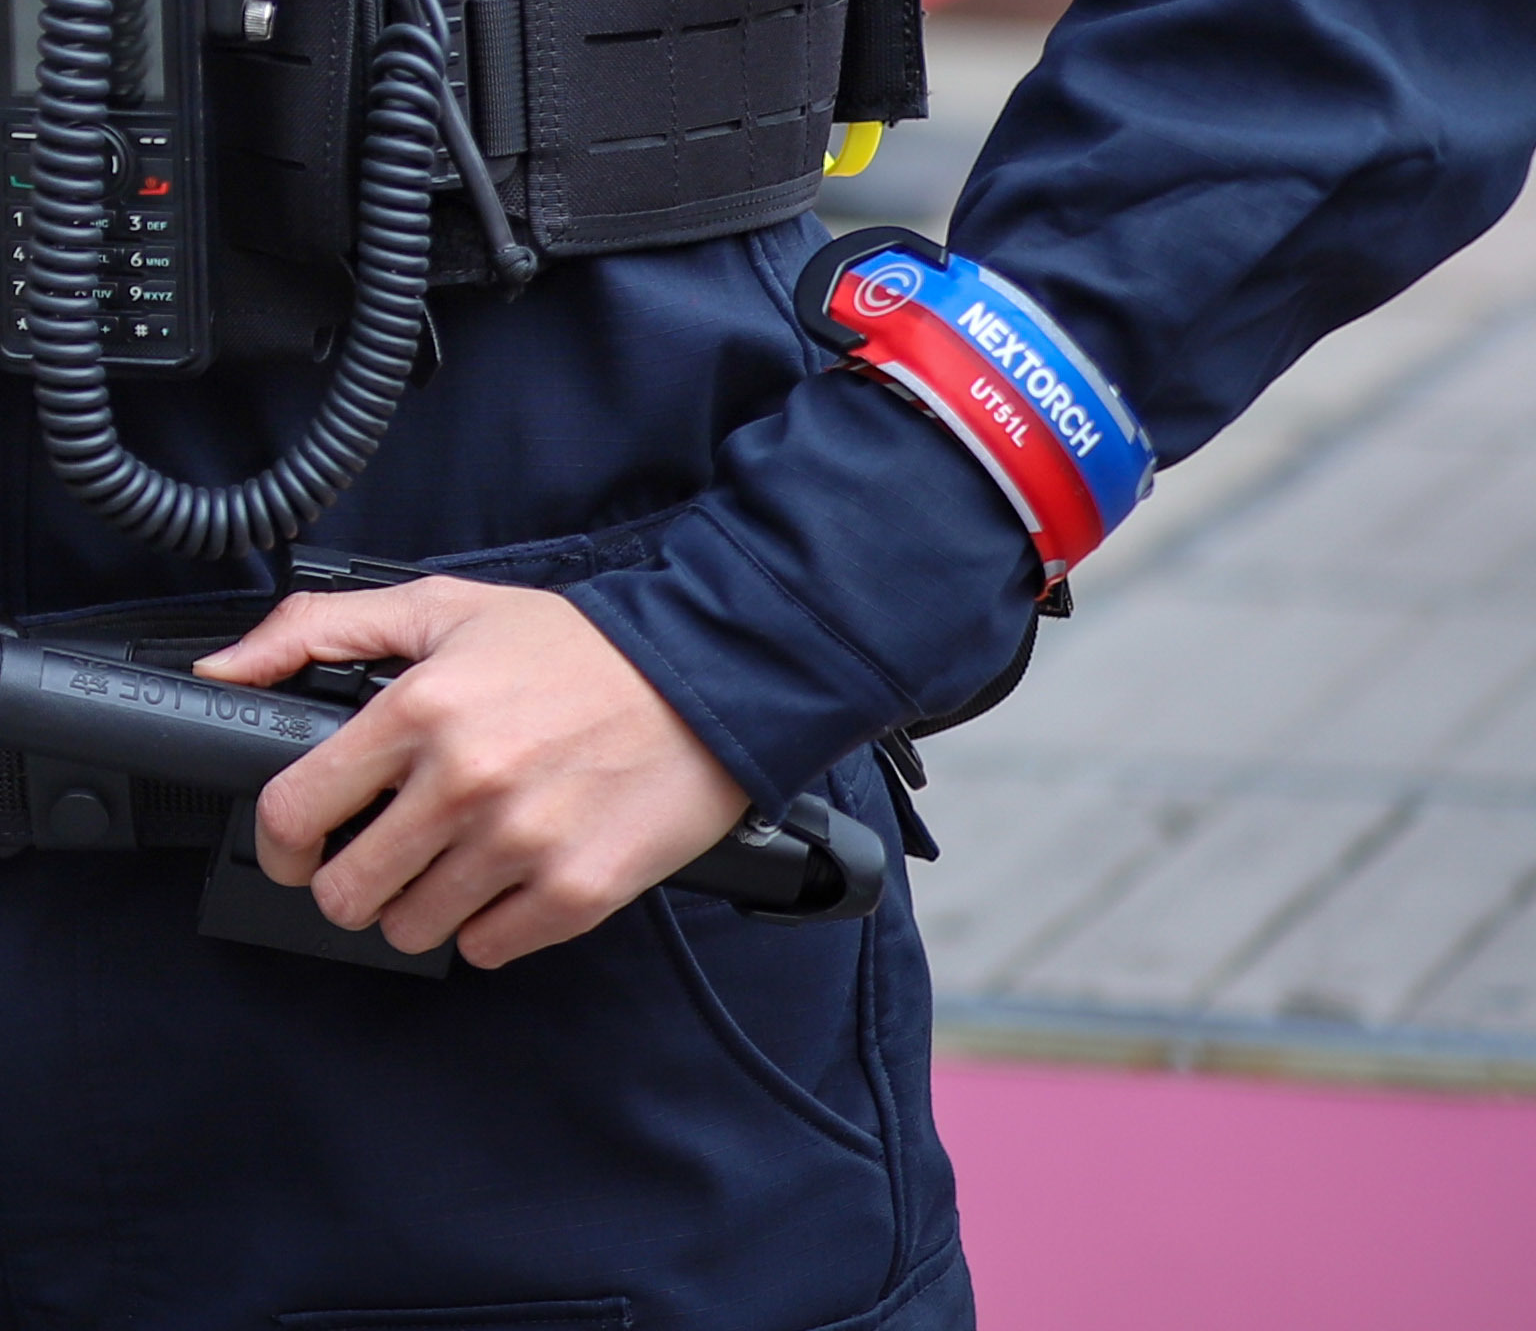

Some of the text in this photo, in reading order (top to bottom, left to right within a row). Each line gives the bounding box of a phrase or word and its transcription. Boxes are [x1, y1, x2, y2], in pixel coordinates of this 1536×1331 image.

[13, 211, 22, 227] 1
[129, 215, 141, 231] 3
[147, 221, 168, 231] DEF
[13, 246, 25, 262] 4
[130, 251, 142, 267] 6
[146, 257, 170, 267] MNO
[13, 281, 25, 296] 7
[129, 285, 142, 302] 9
[143, 291, 173, 302] WXYZ
[957, 301, 1102, 459] NEXTORCH
[969, 376, 1031, 449] UT51L
[119, 669, 261, 727] POLICE
